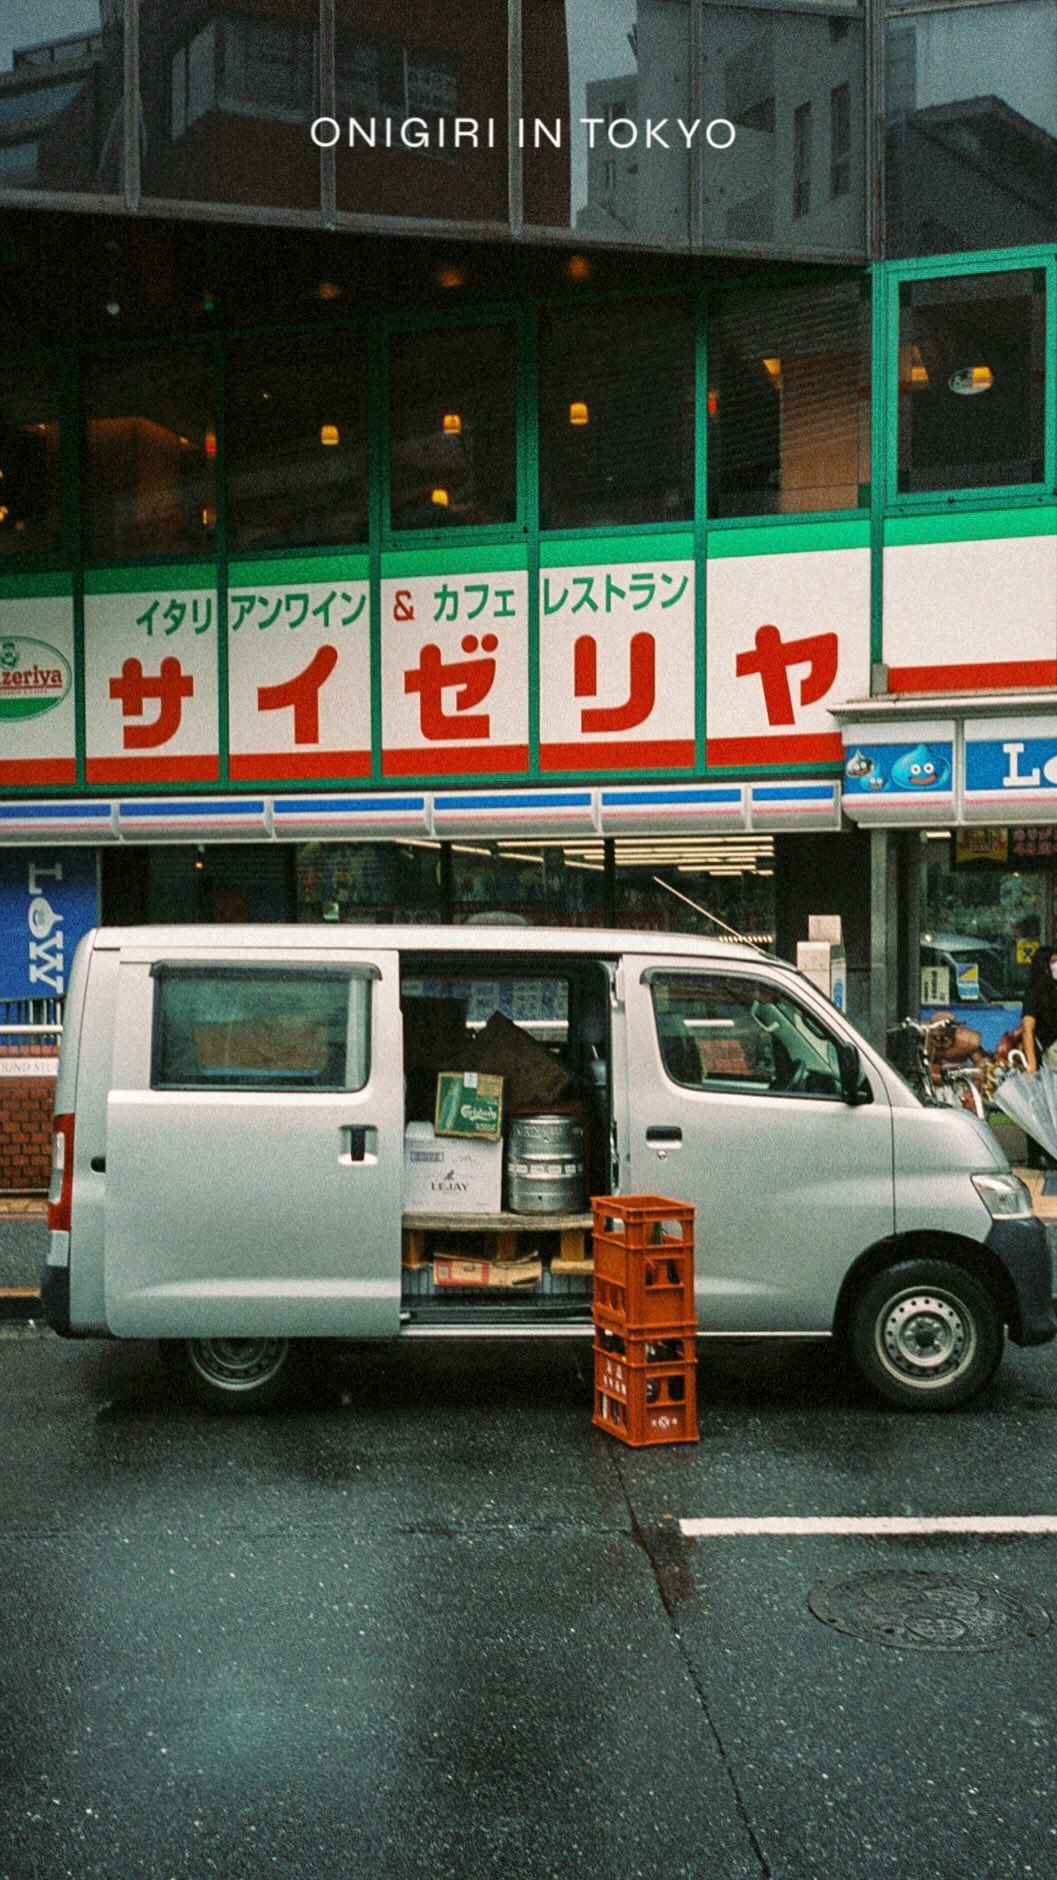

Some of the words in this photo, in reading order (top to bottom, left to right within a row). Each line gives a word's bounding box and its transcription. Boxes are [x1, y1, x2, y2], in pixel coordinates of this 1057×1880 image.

[136, 590, 367, 637] イタリアンワイン
[393, 590, 415, 621] &
[0, 665, 63, 688] zeriya
[108, 624, 839, 749] サイゼリヤ
